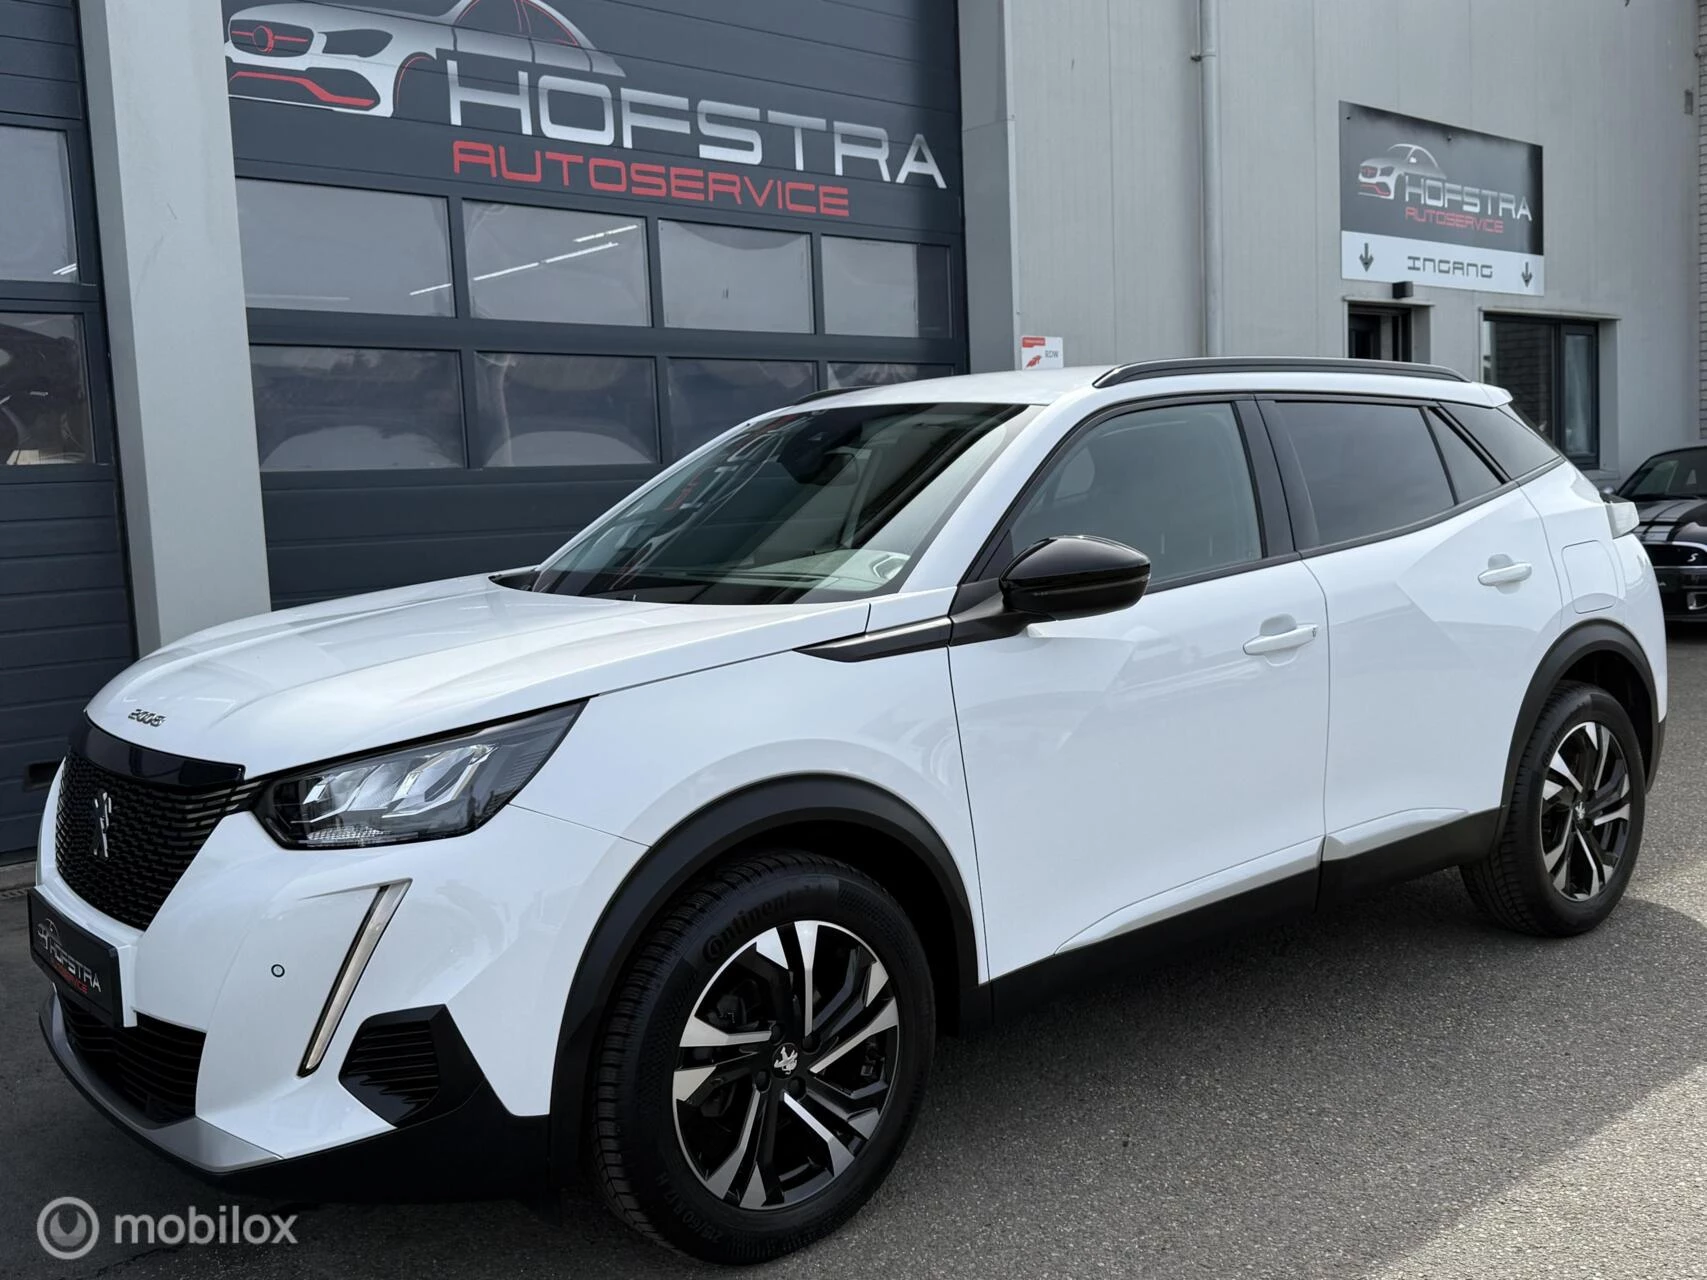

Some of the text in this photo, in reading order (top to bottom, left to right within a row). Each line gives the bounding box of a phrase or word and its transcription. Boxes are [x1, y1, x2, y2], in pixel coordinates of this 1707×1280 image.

[447, 60, 947, 188] HOFSTRA
[453, 141, 849, 216] AUTOSERVICE
[1405, 175, 1532, 221] HOFSTRA
[1405, 207, 1504, 233] AUTOSERVICE
[1407, 256, 1493, 279] INGANG
[702, 886, 815, 962] Continent
